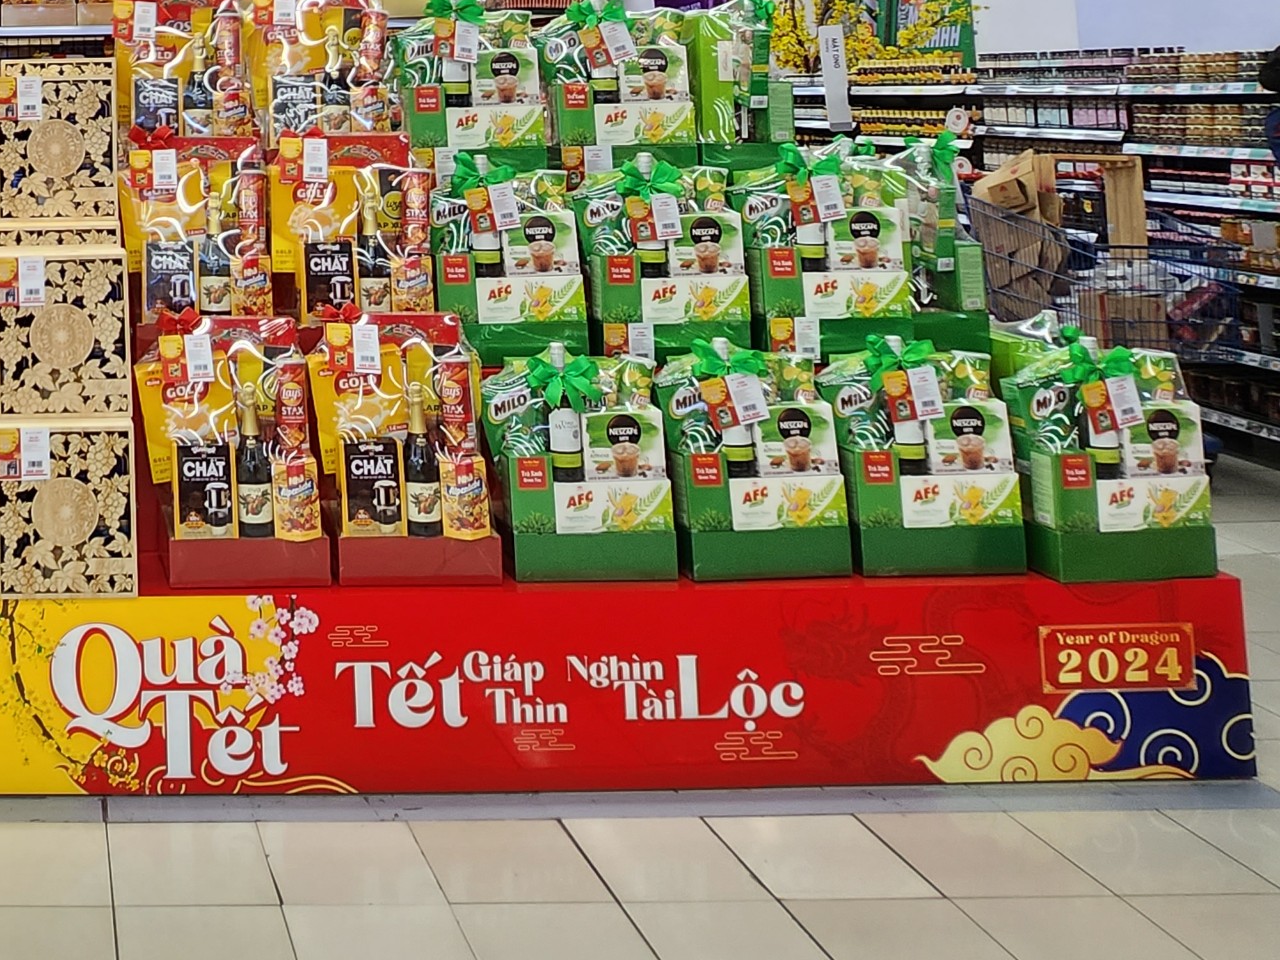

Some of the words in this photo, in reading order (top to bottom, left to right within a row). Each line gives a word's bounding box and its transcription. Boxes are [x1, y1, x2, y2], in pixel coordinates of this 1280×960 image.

[651, 284, 677, 301] AFC
[338, 375, 377, 389] GOLD
[442, 404, 464, 414] STAX
[494, 394, 528, 416] MILO
[567, 489, 594, 510] AFC
[1109, 486, 1135, 506] AFC
[1056, 632, 1094, 645] Year
[1098, 631, 1116, 644] of
[1119, 631, 1180, 645] Dragon
[1058, 647, 1182, 683] 2024
[51, 616, 247, 751] Quà
[335, 651, 469, 728] Tết
[463, 650, 545, 695] Giáp
[566, 653, 664, 689] Nghìn
[676, 654, 805, 732] Lộc
[485, 688, 568, 724] Thìn
[613, 680, 676, 720] Tài
[140, 690, 301, 779] Tết
